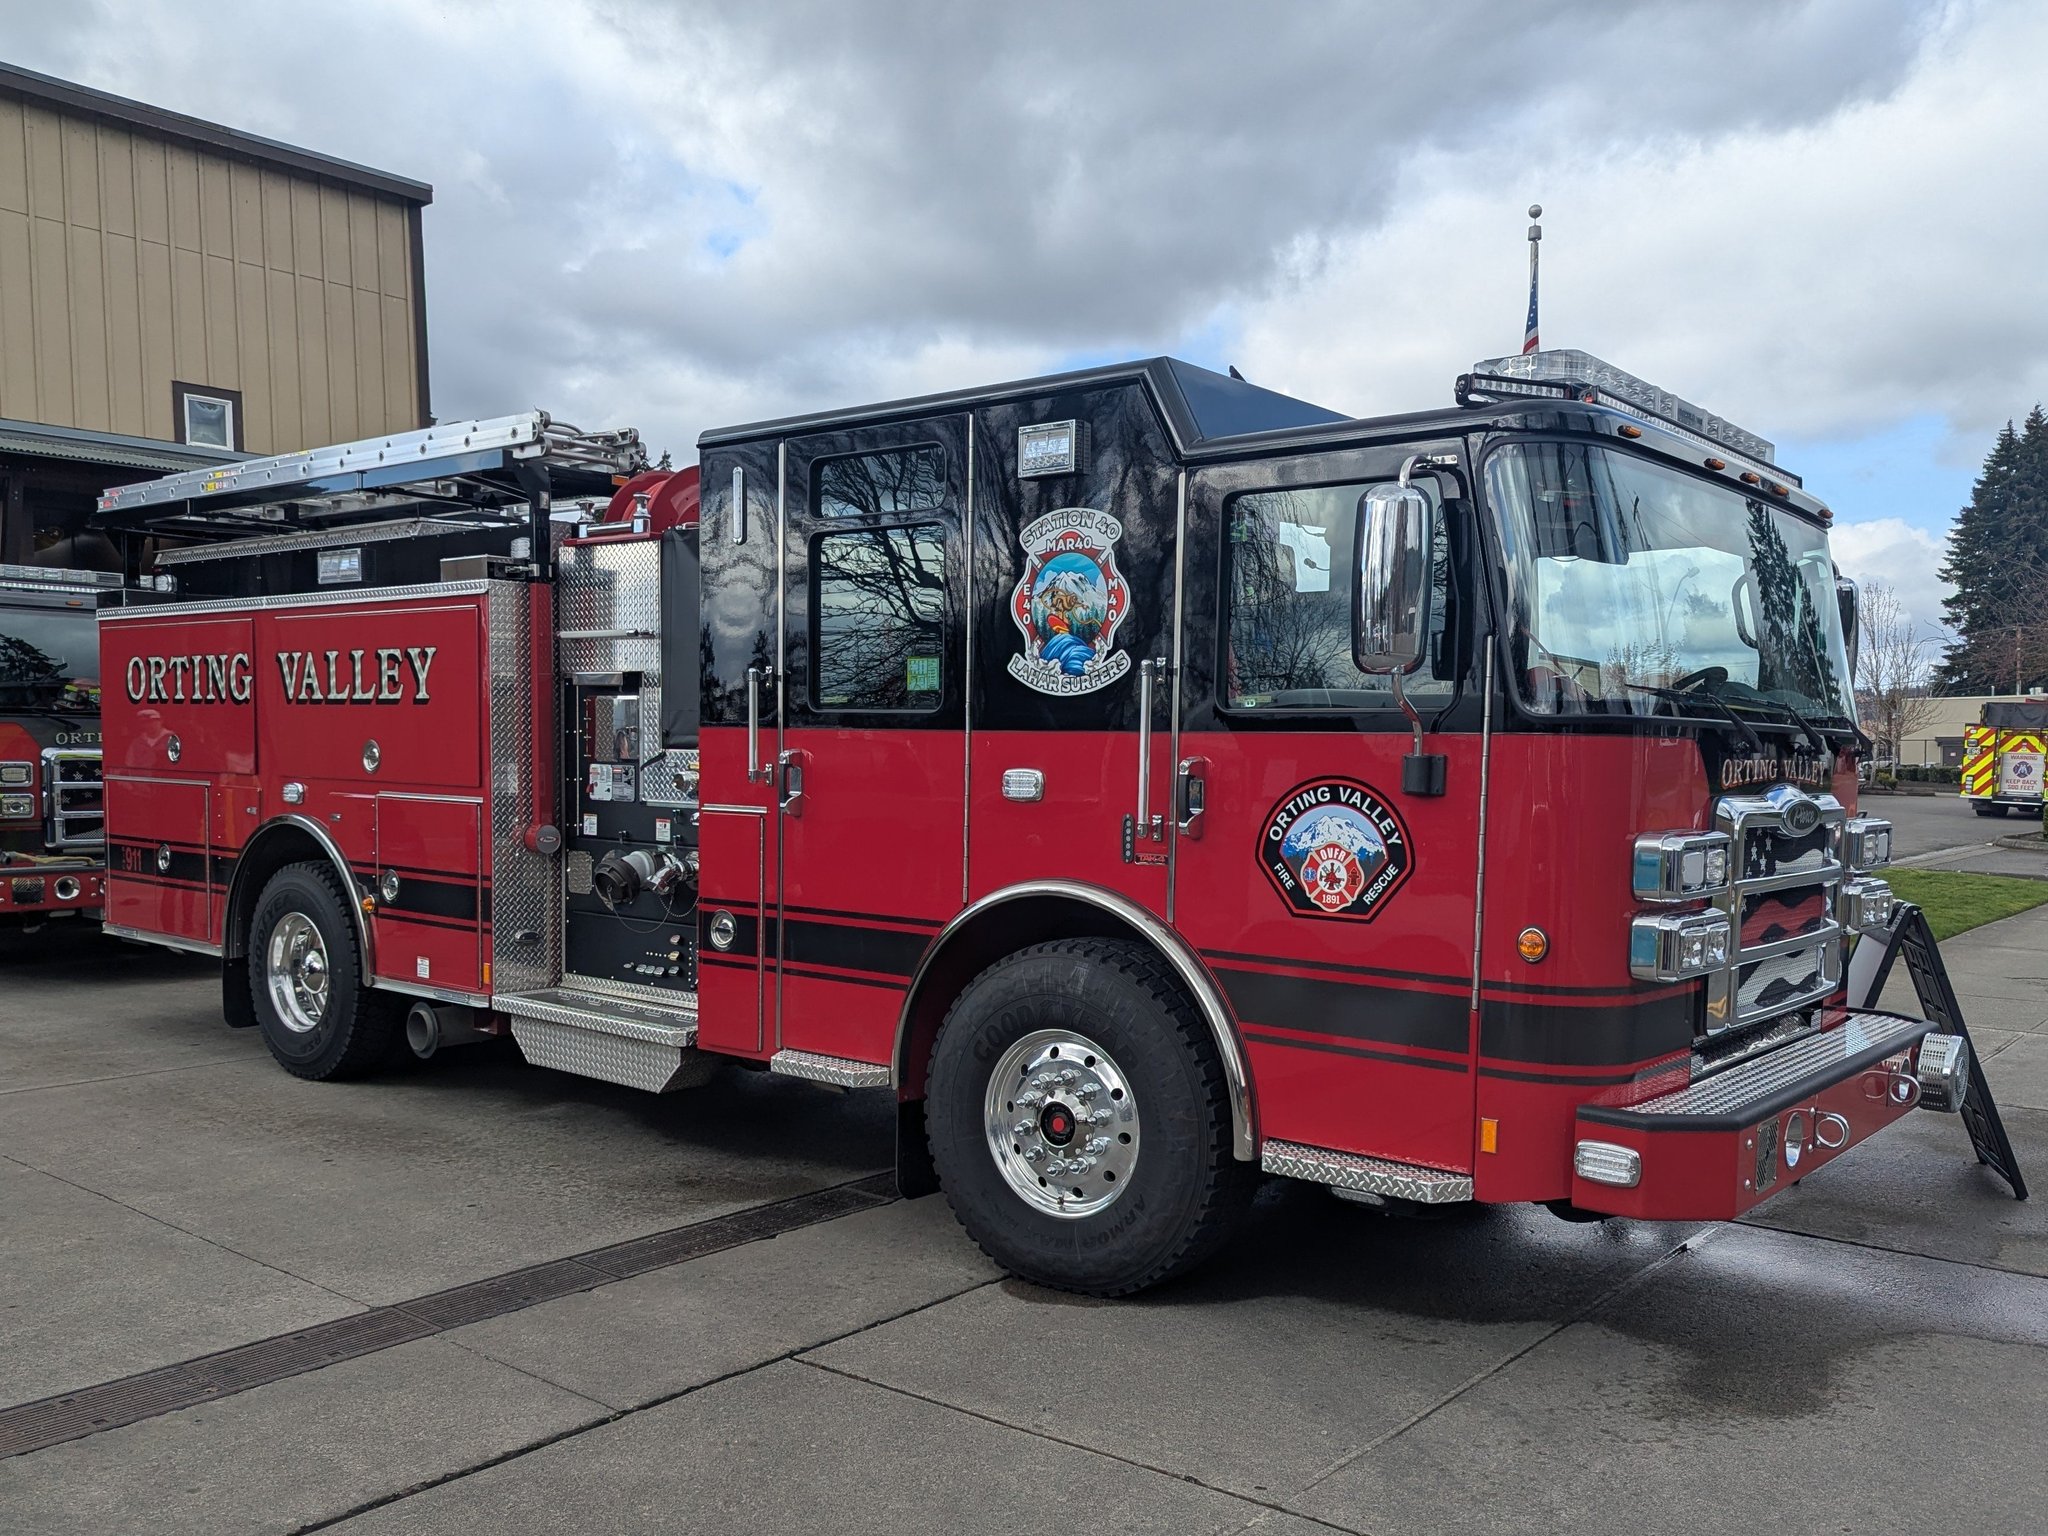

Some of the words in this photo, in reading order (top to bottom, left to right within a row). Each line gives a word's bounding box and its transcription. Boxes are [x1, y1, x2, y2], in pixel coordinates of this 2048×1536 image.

[1023, 511, 1095, 547] STATION
[1095, 518, 1120, 540] 40
[1047, 537, 1092, 552] MAR40
[1022, 584, 1031, 625] E40
[1108, 578, 1118, 621] M40
[126, 653, 252, 702] ORTING
[276, 647, 437, 704] VALLEY
[1012, 657, 1059, 692] LAHAR
[1061, 652, 1130, 693] SURFERS
[55, 732, 103, 745] ORTI
[1722, 759, 1777, 787] ORTING
[1783, 760, 1826, 786] VALLEY
[1269, 786, 1331, 842] ORTING
[1338, 786, 1402, 846] VALLEY
[125, 846, 141, 871] 911
[1320, 847, 1346, 862] OVFR
[1274, 863, 1295, 890] FIRE
[1363, 864, 1398, 905] RESCUE
[1322, 894, 1340, 904] 1891
